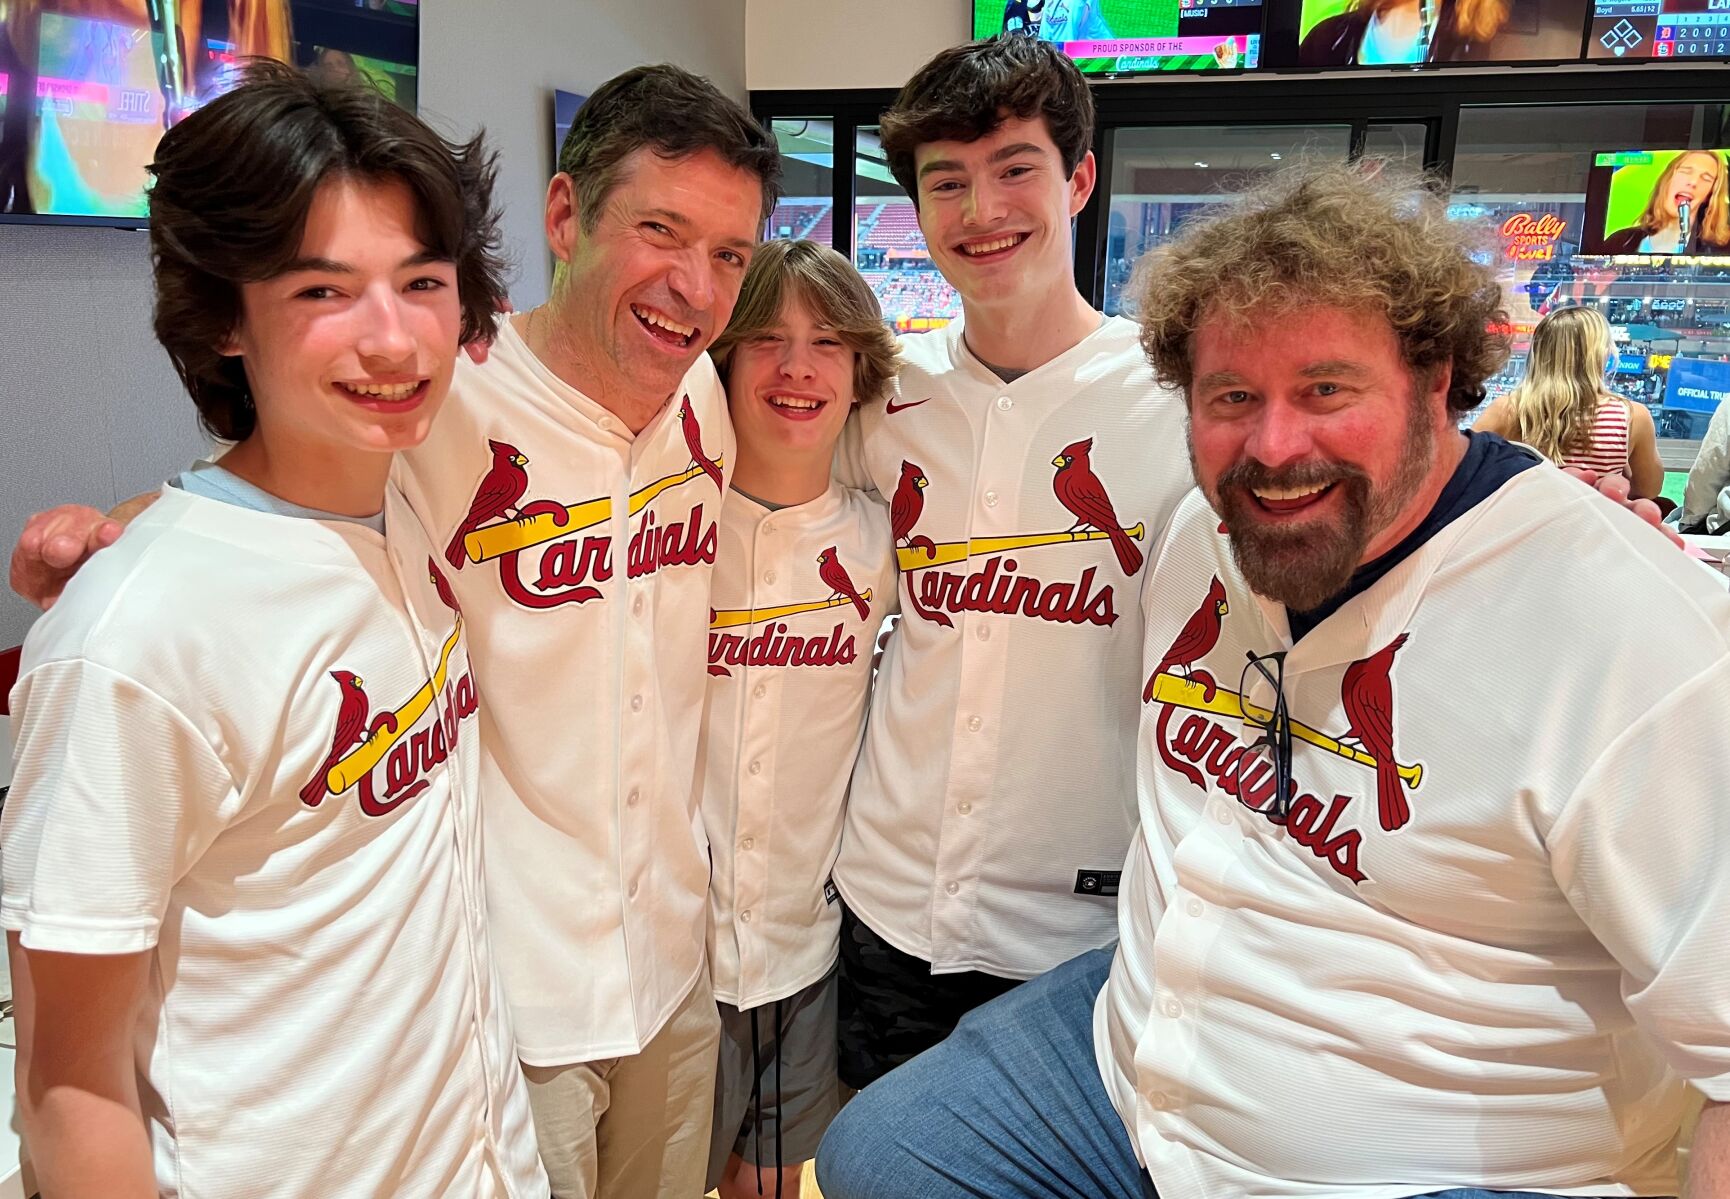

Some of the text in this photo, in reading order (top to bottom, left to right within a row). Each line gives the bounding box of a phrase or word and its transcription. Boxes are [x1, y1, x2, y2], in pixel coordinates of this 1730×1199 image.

[1092, 42, 1183, 53] PROUD SPONSOR OF THE
[1115, 54, 1159, 71] Cardinals
[1503, 213, 1567, 241] Bally
[1514, 235, 1549, 246] SPORTS
[1677, 386, 1730, 401] OFFICIAL TRU
[906, 536, 1120, 629] Cardinals
